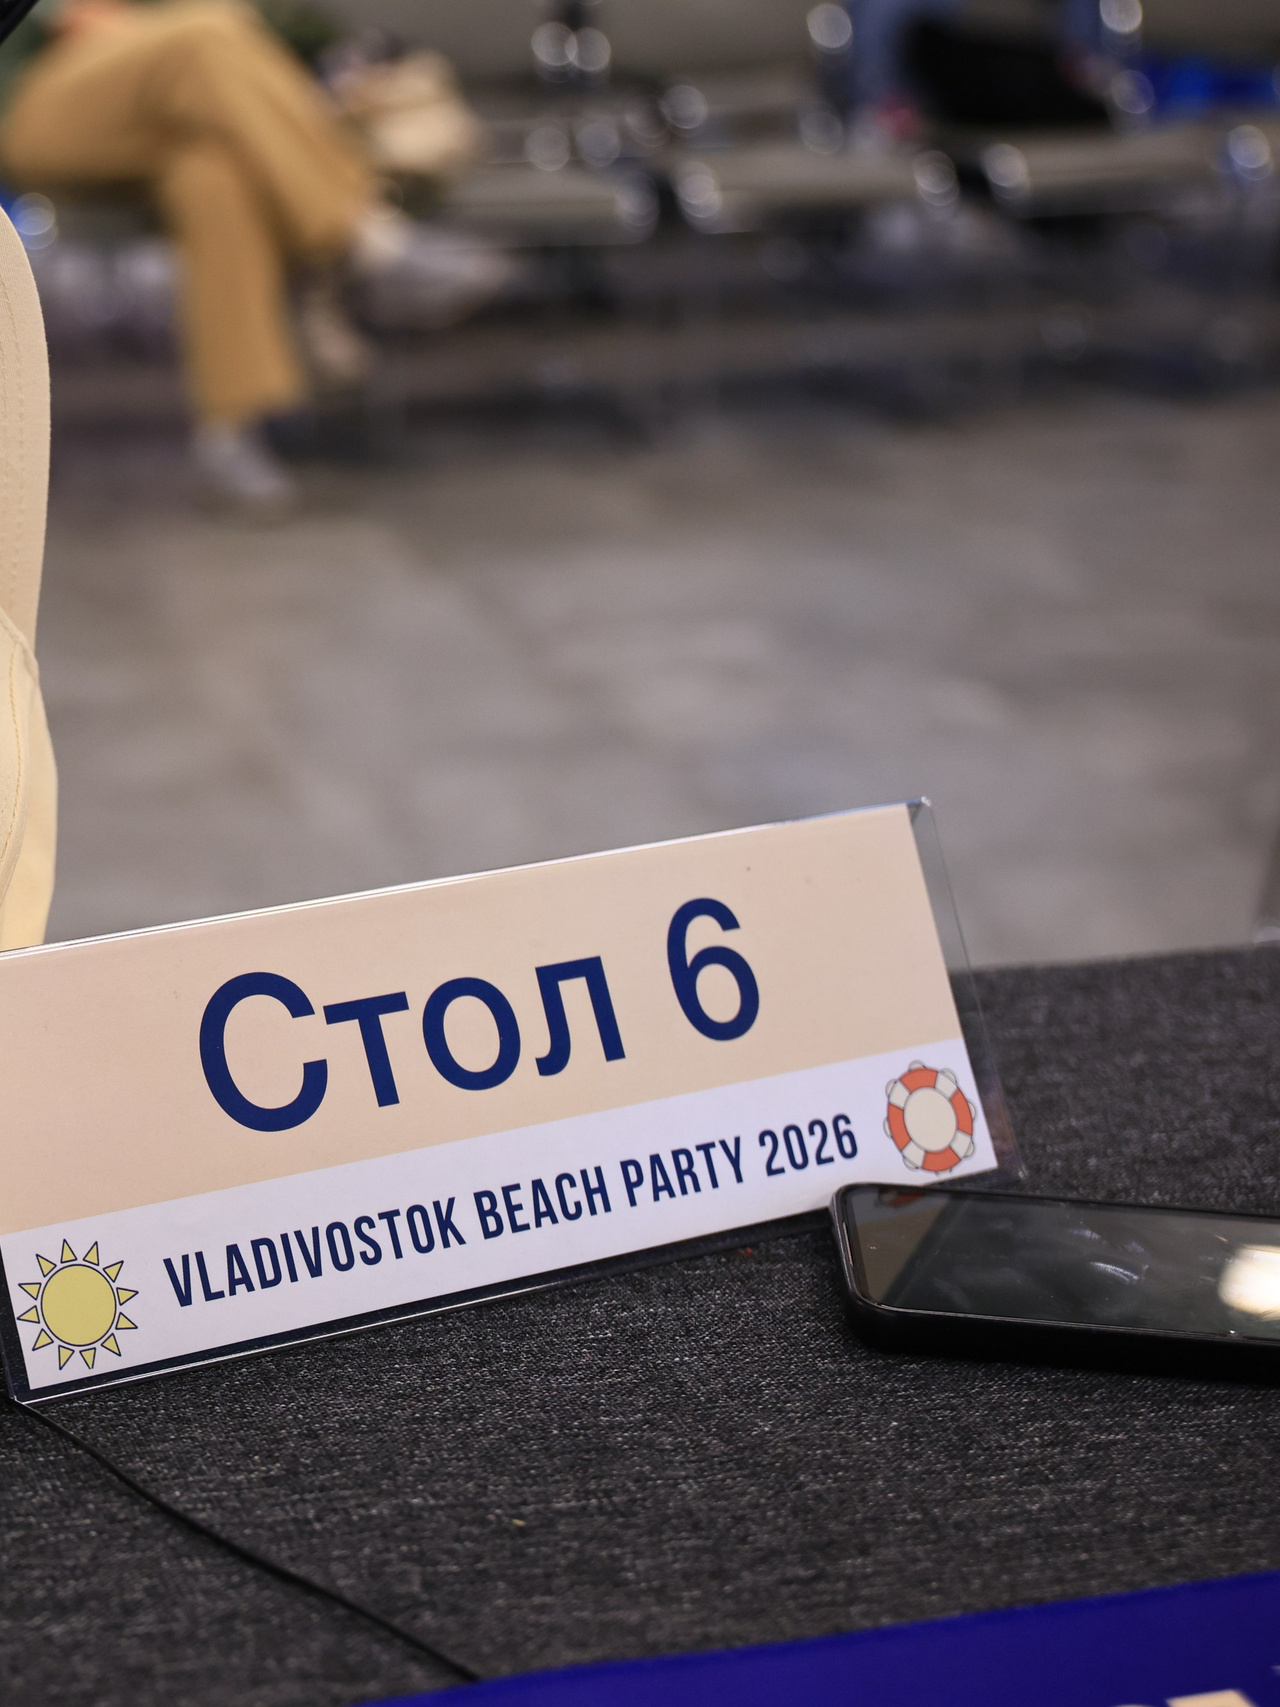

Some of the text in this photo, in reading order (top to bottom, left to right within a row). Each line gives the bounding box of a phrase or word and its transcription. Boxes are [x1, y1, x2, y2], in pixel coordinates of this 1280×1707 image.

[198, 898, 760, 1132] Стол 6
[163, 1113, 859, 1308] VLADIVOSTOK BEACH PARTY 2026
